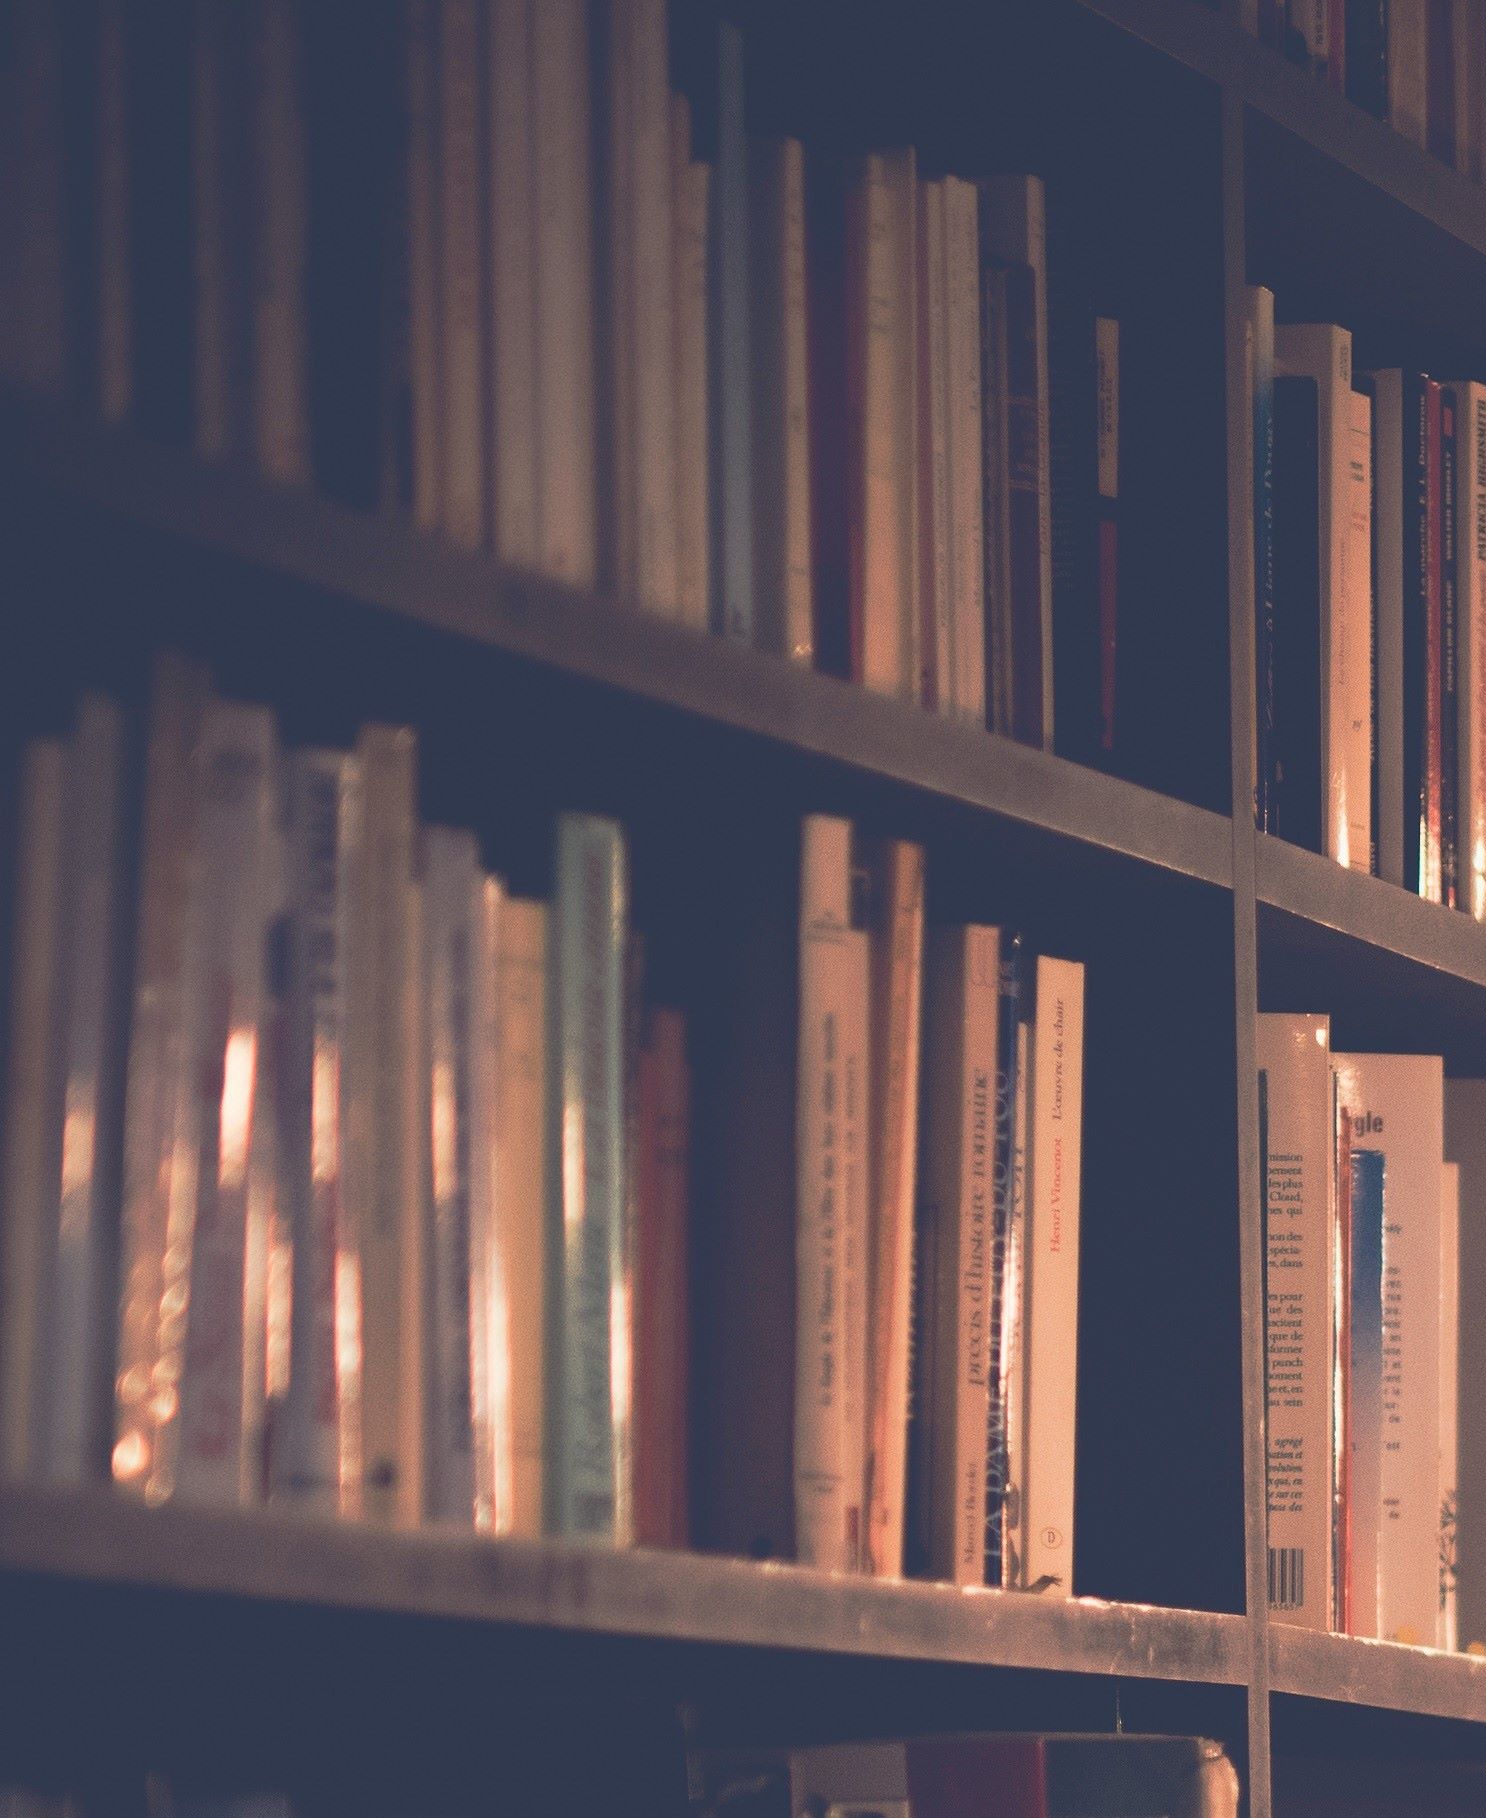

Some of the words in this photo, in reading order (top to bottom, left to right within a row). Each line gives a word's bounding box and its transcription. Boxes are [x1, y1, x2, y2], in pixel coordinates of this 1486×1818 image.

[1052, 999, 1065, 1036] chair
[1052, 1038, 1064, 1058] de
[969, 1067, 987, 1177] romaine
[1350, 1110, 1384, 1138] gle
[1049, 1137, 1063, 1205] Vincenot
[964, 1185, 986, 1304] d'histoire
[1049, 1208, 1061, 1253] Henri
[967, 1311, 985, 1385] précis
